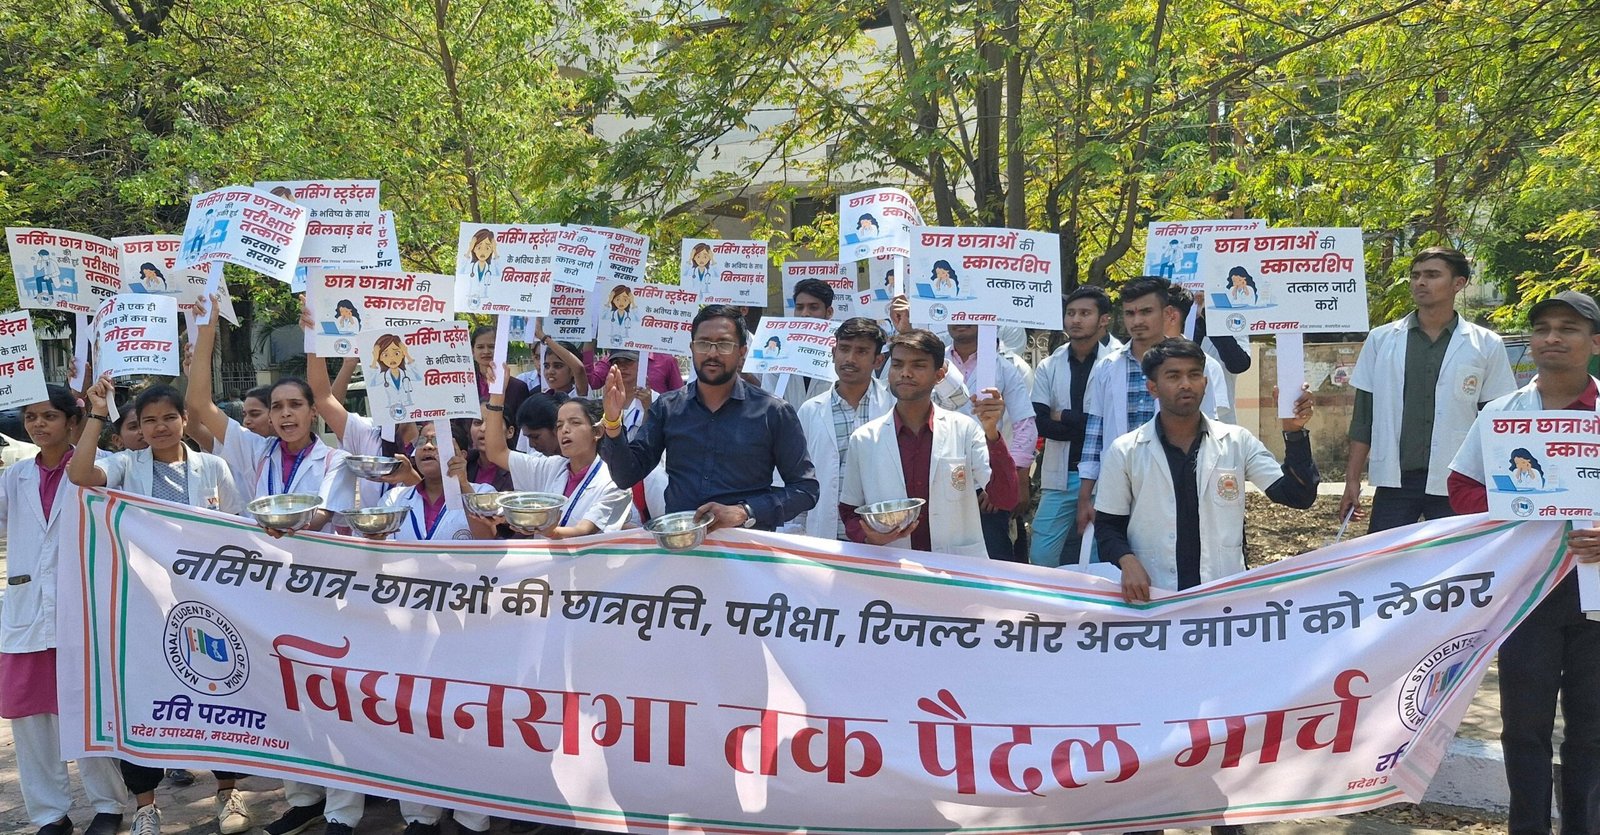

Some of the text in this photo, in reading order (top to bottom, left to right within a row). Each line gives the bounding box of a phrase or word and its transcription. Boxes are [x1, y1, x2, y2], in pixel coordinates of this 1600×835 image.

[295, 183, 376, 205] नर्सिंग स्टूडेंट्स
[849, 194, 876, 208] छात्र
[196, 191, 304, 221] नर्सिंग छात्र छात्राओं
[310, 208, 371, 218] के भविष्य के साथ
[242, 208, 296, 234] परीक्षाएं
[239, 220, 293, 246] तत्काल
[305, 221, 354, 239] खिलवाड़
[356, 221, 374, 236] बंद
[496, 228, 527, 244] नर्सिंग
[1155, 224, 1188, 236] नर्सिंग
[16, 230, 119, 260] नर्सिंग छात्र छात्राओं
[124, 240, 154, 254] छात्र
[240, 235, 281, 256] करवाएं
[921, 232, 1035, 252] छात्र छात्राओं की
[1215, 231, 1336, 253] छात्र छात्राओं की
[609, 243, 642, 258] परीक्षाएं
[713, 242, 766, 259] नर्सिंग स्टूडेंट्स
[82, 255, 120, 276] परीक्षाएं
[246, 248, 287, 270] सरकार
[506, 255, 513, 264] के
[514, 255, 534, 264] भविष्य
[608, 252, 641, 266] तत्काल
[962, 253, 1051, 274] स्कालरशिप
[1260, 253, 1355, 275] स्कालरशिप
[609, 263, 634, 274] करवाएं
[788, 266, 806, 275] छात्र
[807, 264, 840, 275] छात्राओं
[85, 270, 122, 289] तत्काल
[325, 274, 431, 293] छात्र छात्राओं की
[501, 267, 540, 287] खिलवाड़
[613, 271, 639, 283] सरकार
[720, 271, 754, 286] खिलवाड़
[986, 277, 1053, 294] तत्काल जारी
[1287, 279, 1357, 294] तत्काल जारी
[364, 295, 447, 314] स्कालरशिप
[633, 286, 698, 307] नर्सिंग स्टूडेंट्स
[1012, 295, 1035, 308] करों
[1315, 297, 1339, 311] करों
[117, 302, 125, 312] से
[127, 303, 145, 311] एक
[645, 306, 652, 314] के
[672, 308, 679, 317] के
[641, 316, 680, 333] खिलवाड़
[951, 311, 967, 322] रवि
[967, 312, 997, 322] परमार
[104, 326, 146, 342] मोहन
[559, 326, 586, 335] सरकार
[765, 319, 831, 333] छात्र छात्राओं
[1250, 321, 1267, 331] रवि
[1268, 321, 1300, 330] परमार
[404, 328, 441, 346] नर्सिंग
[11, 344, 28, 355] साथ
[117, 339, 173, 352] सरकार
[797, 346, 826, 358] तत्काल
[17, 356, 35, 372] बंद
[426, 355, 434, 366] के
[435, 355, 456, 365] भविष्य
[424, 369, 467, 388] खिलवाड़
[410, 409, 422, 418] रवि
[423, 409, 446, 418] परमार
[1492, 418, 1532, 434] छात्र
[1539, 506, 1557, 517] रवि
[1560, 507, 1593, 517] परमार
[172, 545, 1495, 653] नर्सिंग छात्र-छात्राओं की छात्रवृत्ति, परीक्षा, रिजल्ट और अन्य मांगों को लेकर
[216, 617, 242, 650] UNION
[169, 632, 200, 685] NATIONAL
[236, 653, 245, 669] OF
[224, 668, 245, 689] INDIA
[152, 695, 267, 730] रवि परमार
[269, 634, 1372, 798] विधानसभा तक पैदल मार्च
[131, 725, 157, 740] प्रदेश
[159, 725, 209, 743] उपाध्यक्ष,
[210, 729, 262, 747] मध्यप्रदेश
[262, 735, 290, 750] NSUI
[1347, 777, 1379, 791] प्रदेश
